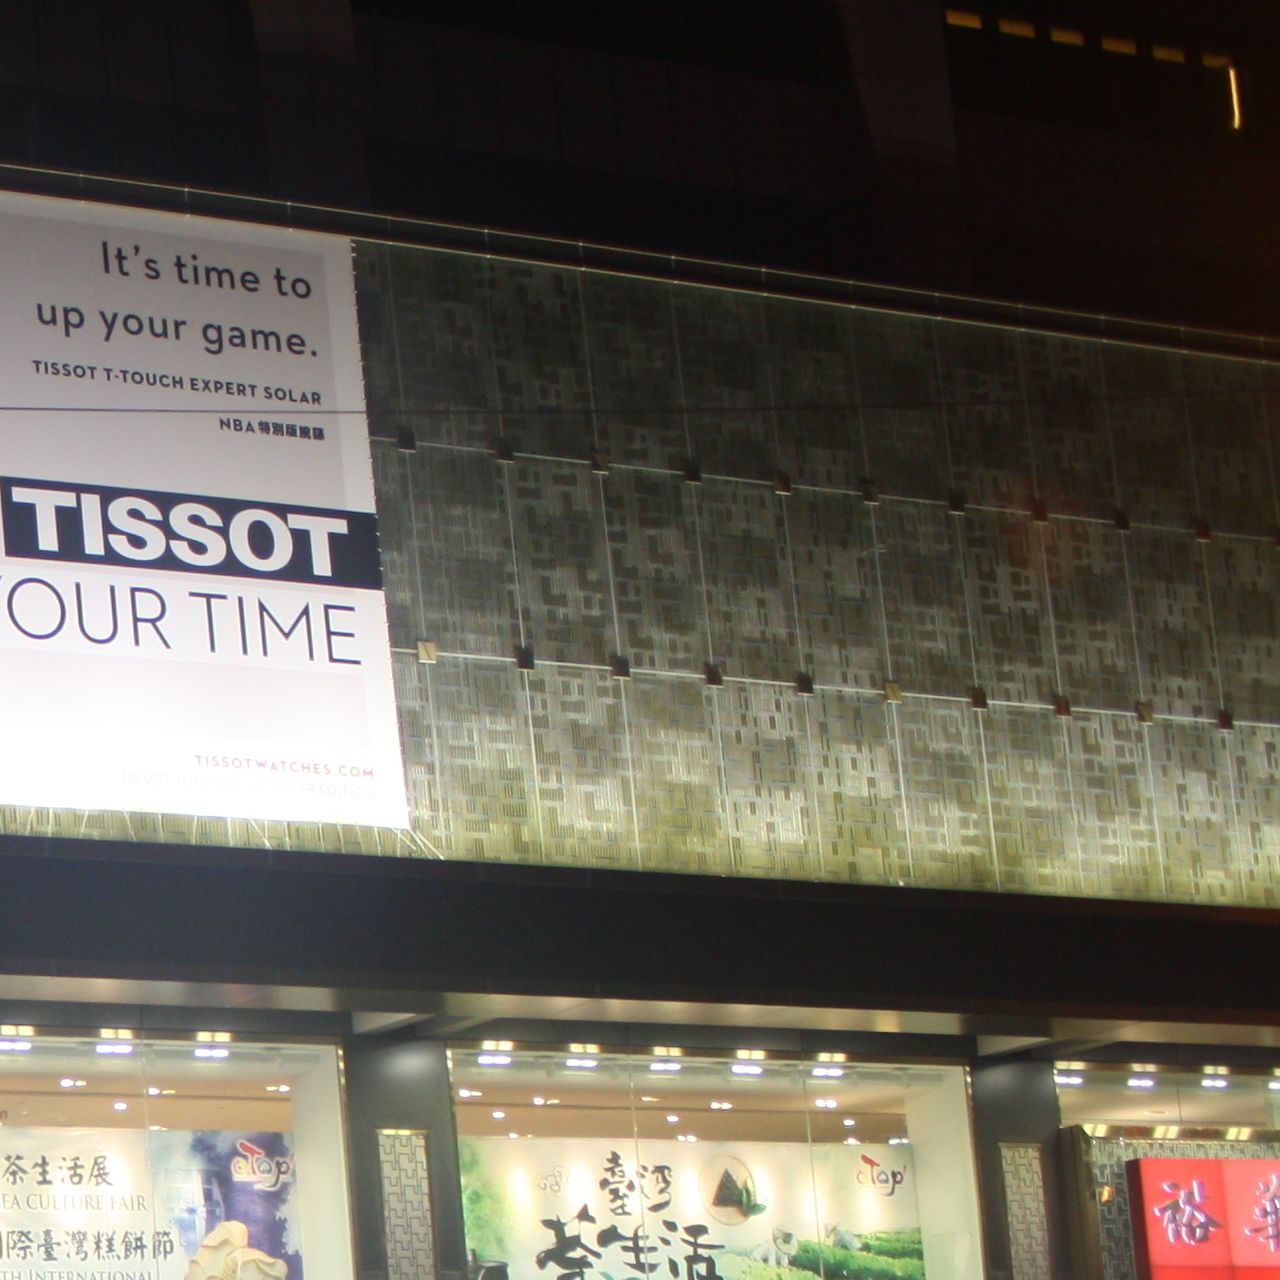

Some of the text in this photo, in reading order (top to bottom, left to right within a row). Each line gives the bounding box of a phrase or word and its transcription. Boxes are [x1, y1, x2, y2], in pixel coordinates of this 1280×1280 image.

[174, 254, 261, 293] time
[274, 267, 312, 300] to
[36, 303, 318, 357] up your game.
[32, 360, 322, 406] TISSOT T-TOUCH EXPERT SOLAR
[219, 417, 257, 434] NBA
[11, 486, 349, 578] TISSOT
[189, 592, 363, 667] TIME
[195, 754, 375, 779] TISSOTWATCHES.COM
[25, 1193, 104, 1212] CULTURE
[110, 1194, 149, 1212] FAIR
[599, 1150, 674, 1217] 臺灣
